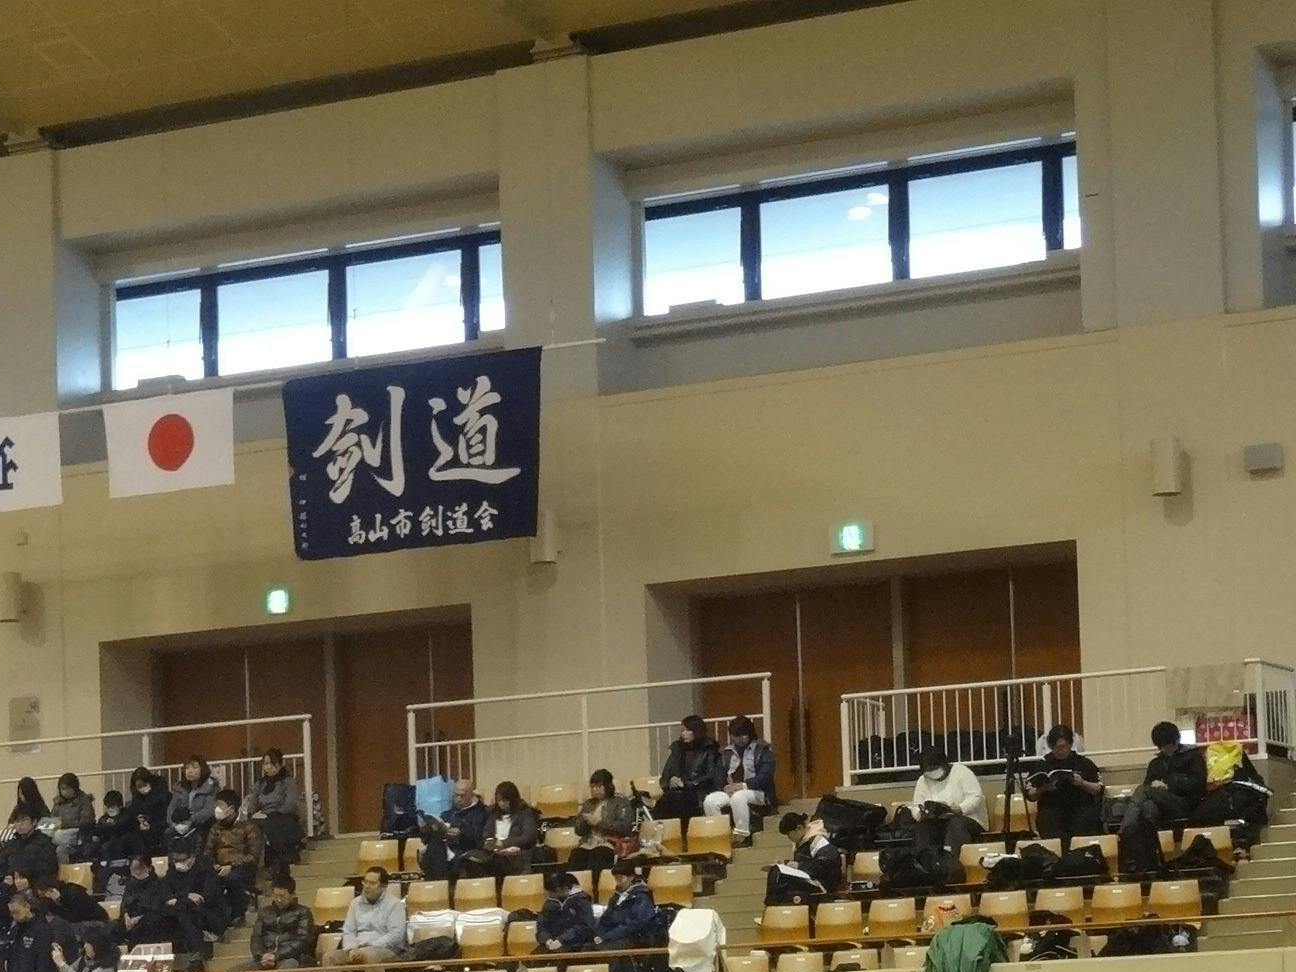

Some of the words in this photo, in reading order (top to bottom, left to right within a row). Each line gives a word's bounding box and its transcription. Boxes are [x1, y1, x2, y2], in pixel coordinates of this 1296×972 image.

[347, 500, 499, 545] 高山市剣道会
